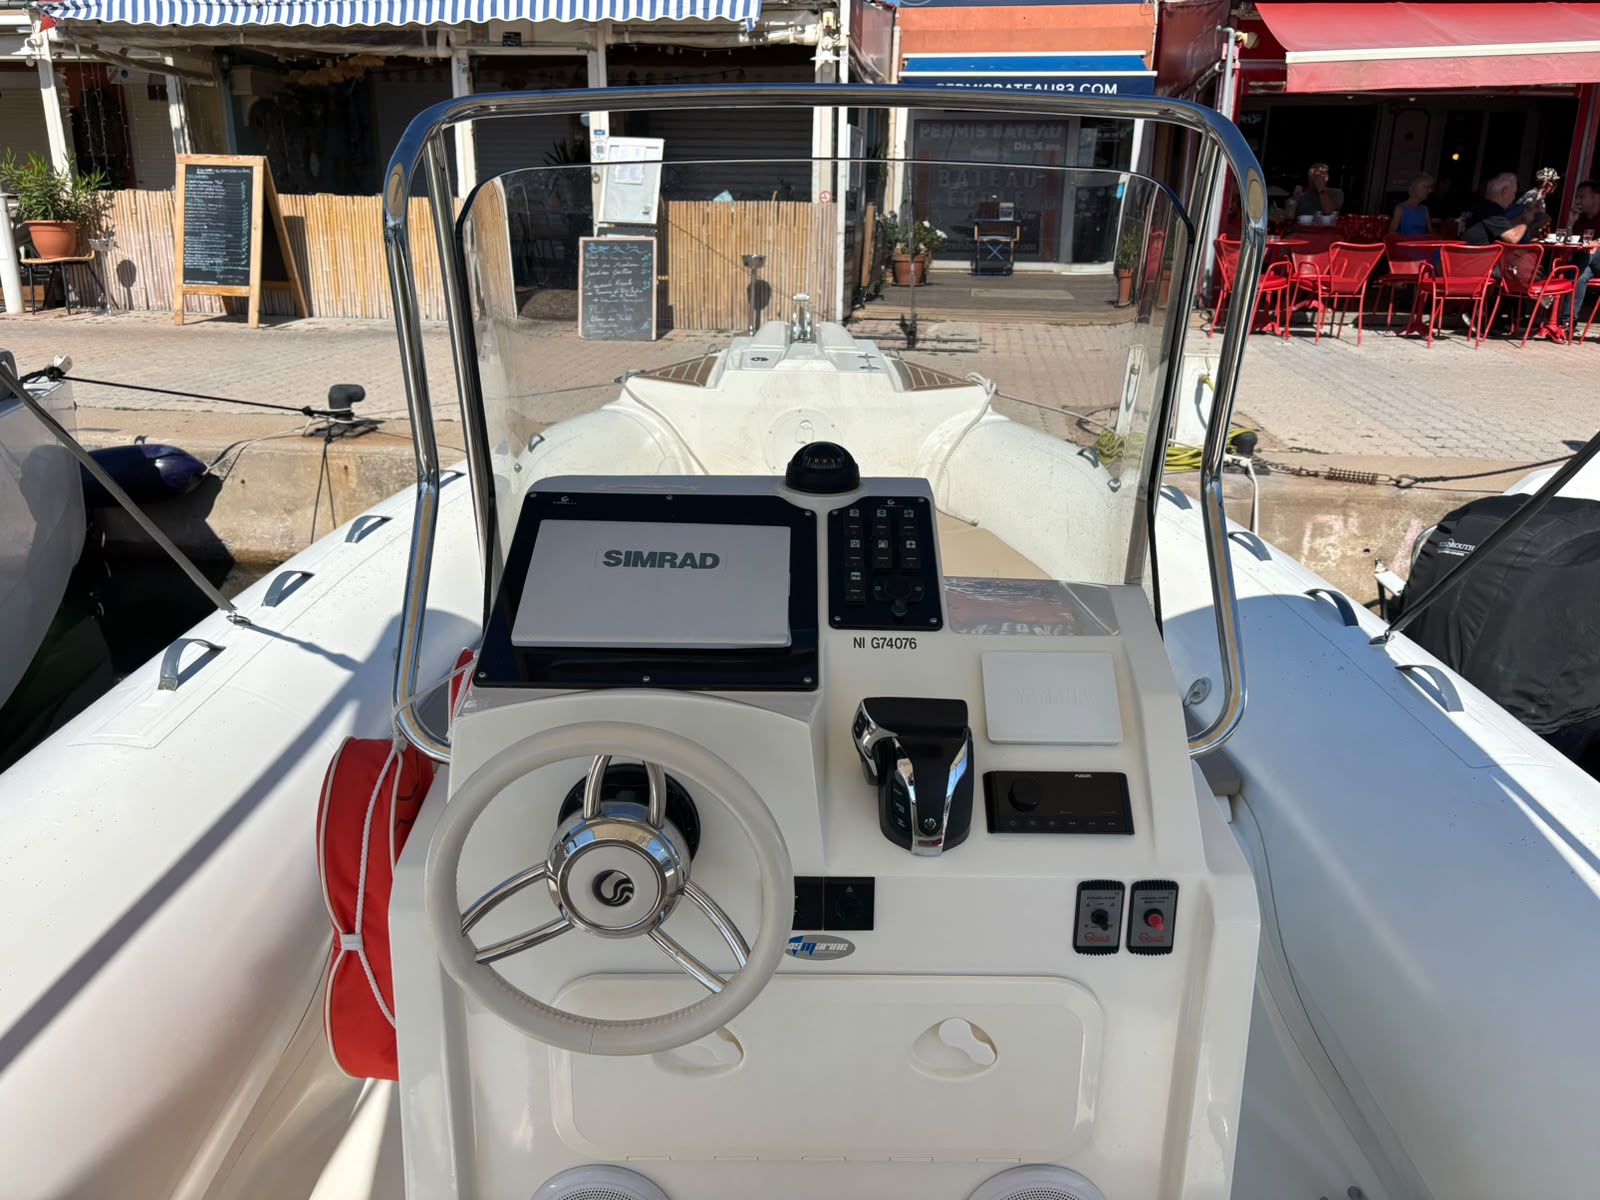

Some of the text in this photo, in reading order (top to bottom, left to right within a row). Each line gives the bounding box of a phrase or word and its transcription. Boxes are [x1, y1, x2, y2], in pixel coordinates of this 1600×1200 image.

[919, 123, 1063, 139] PERMIS BATEAU
[602, 549, 720, 570] SIMRAD
[853, 636, 918, 650] NI G74076
